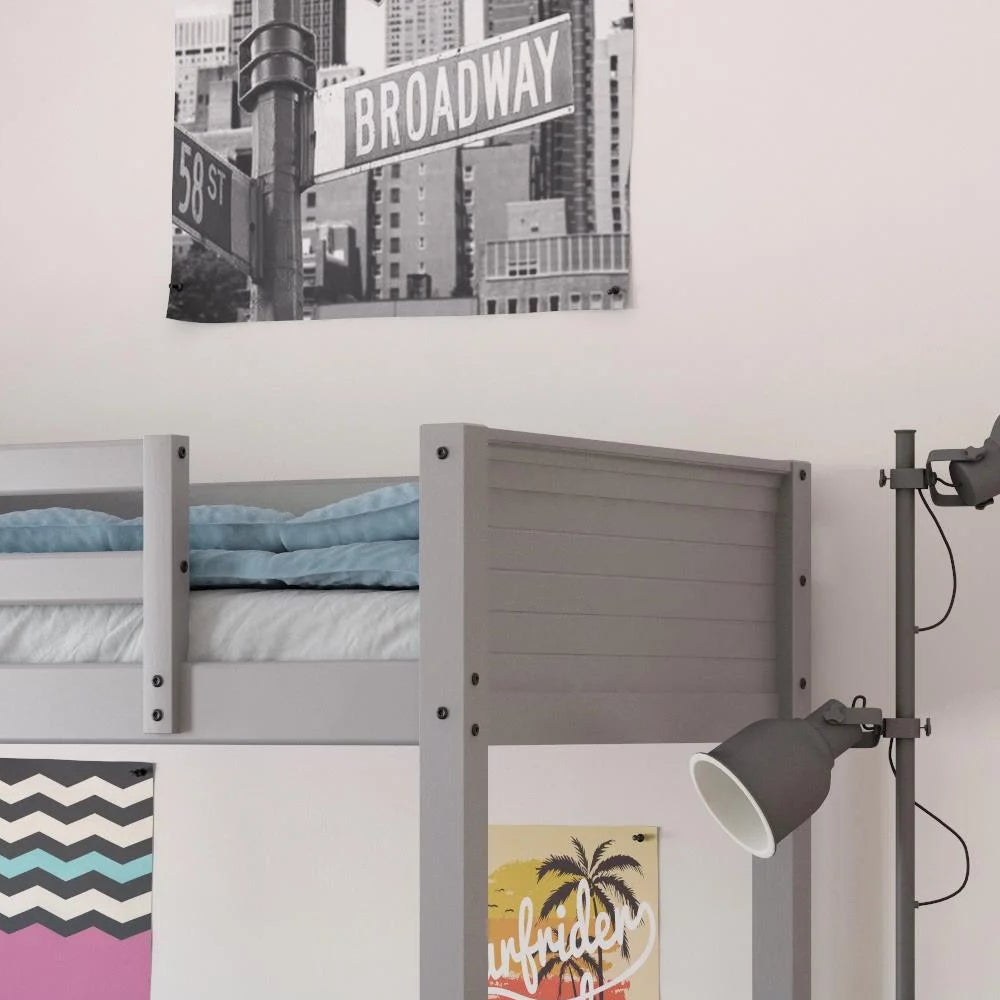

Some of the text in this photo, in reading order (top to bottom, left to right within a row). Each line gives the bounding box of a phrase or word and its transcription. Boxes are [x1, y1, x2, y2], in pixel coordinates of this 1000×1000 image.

[355, 30, 559, 157] BROADWAY
[178, 141, 226, 224] 58 ST
[488, 879, 656, 995] urfrider
